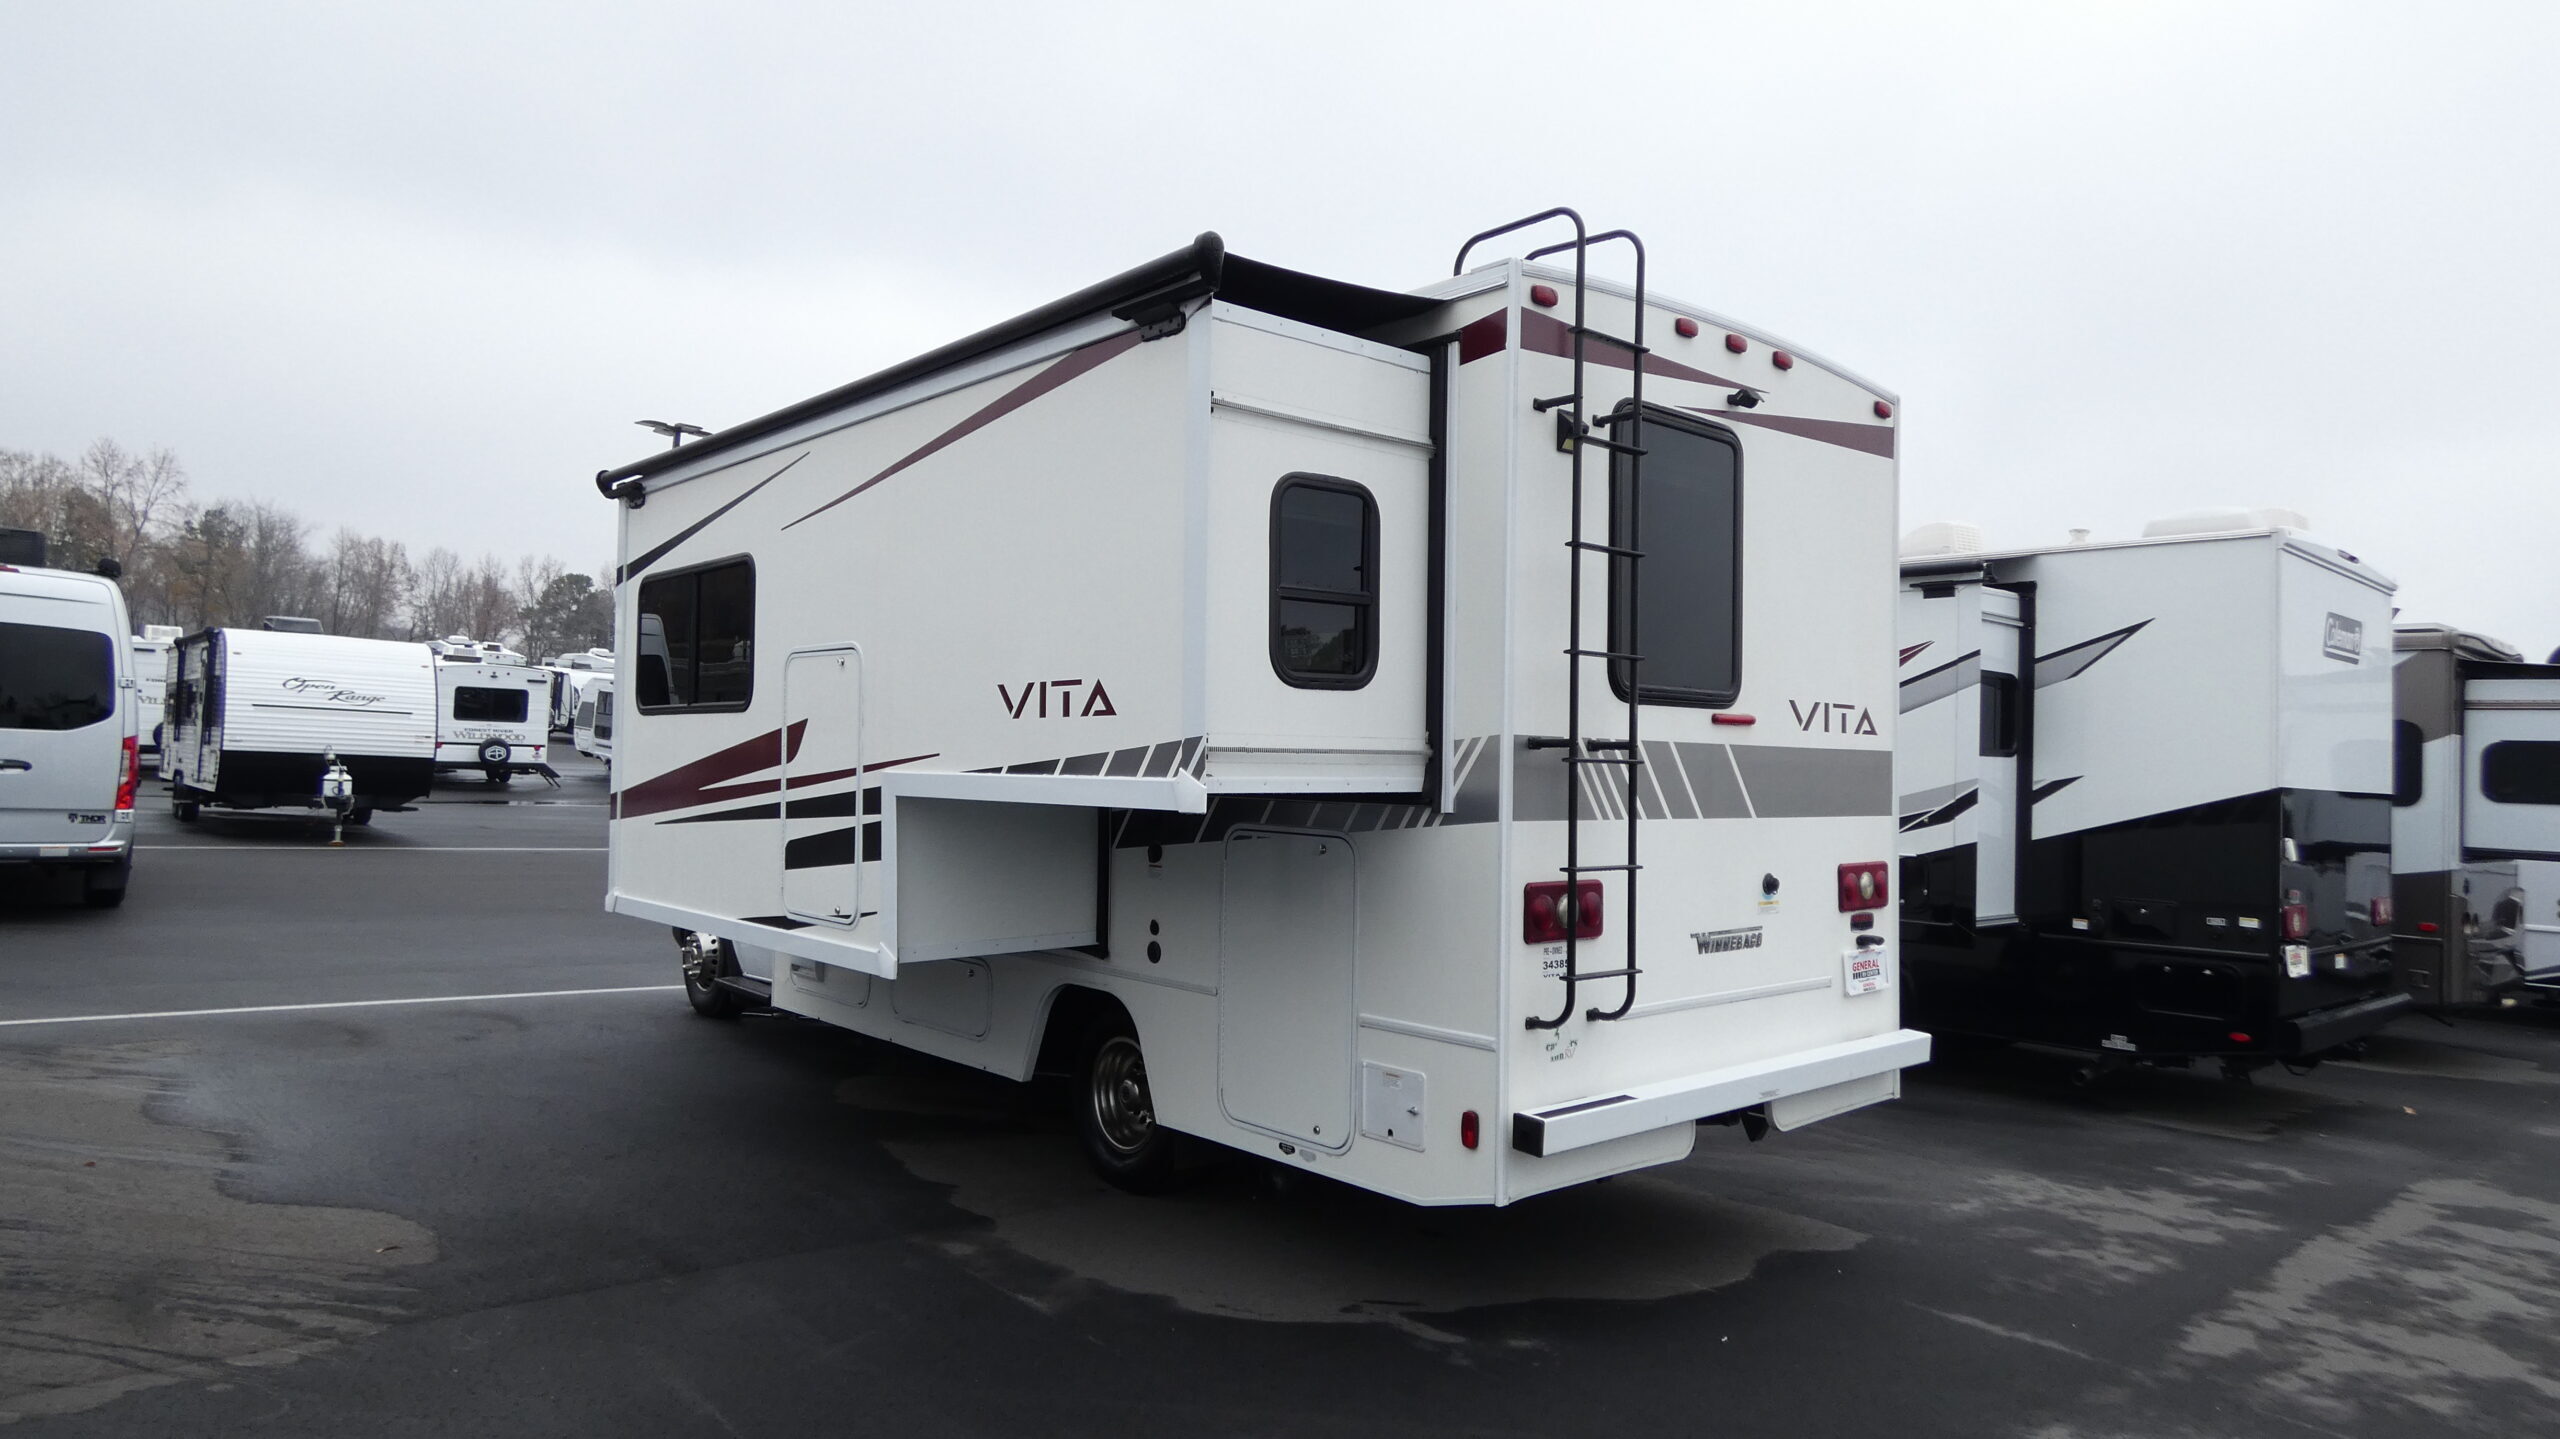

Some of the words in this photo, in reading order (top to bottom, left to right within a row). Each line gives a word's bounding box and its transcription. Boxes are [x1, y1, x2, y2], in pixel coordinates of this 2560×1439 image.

[282, 677, 336, 693] Open
[325, 690, 386, 706] Range
[997, 679, 1117, 719] VITA
[1789, 699, 1878, 736] VITA
[1690, 926, 1763, 955] WINNEBAGO
[1852, 959, 1880, 972] GENERAL
